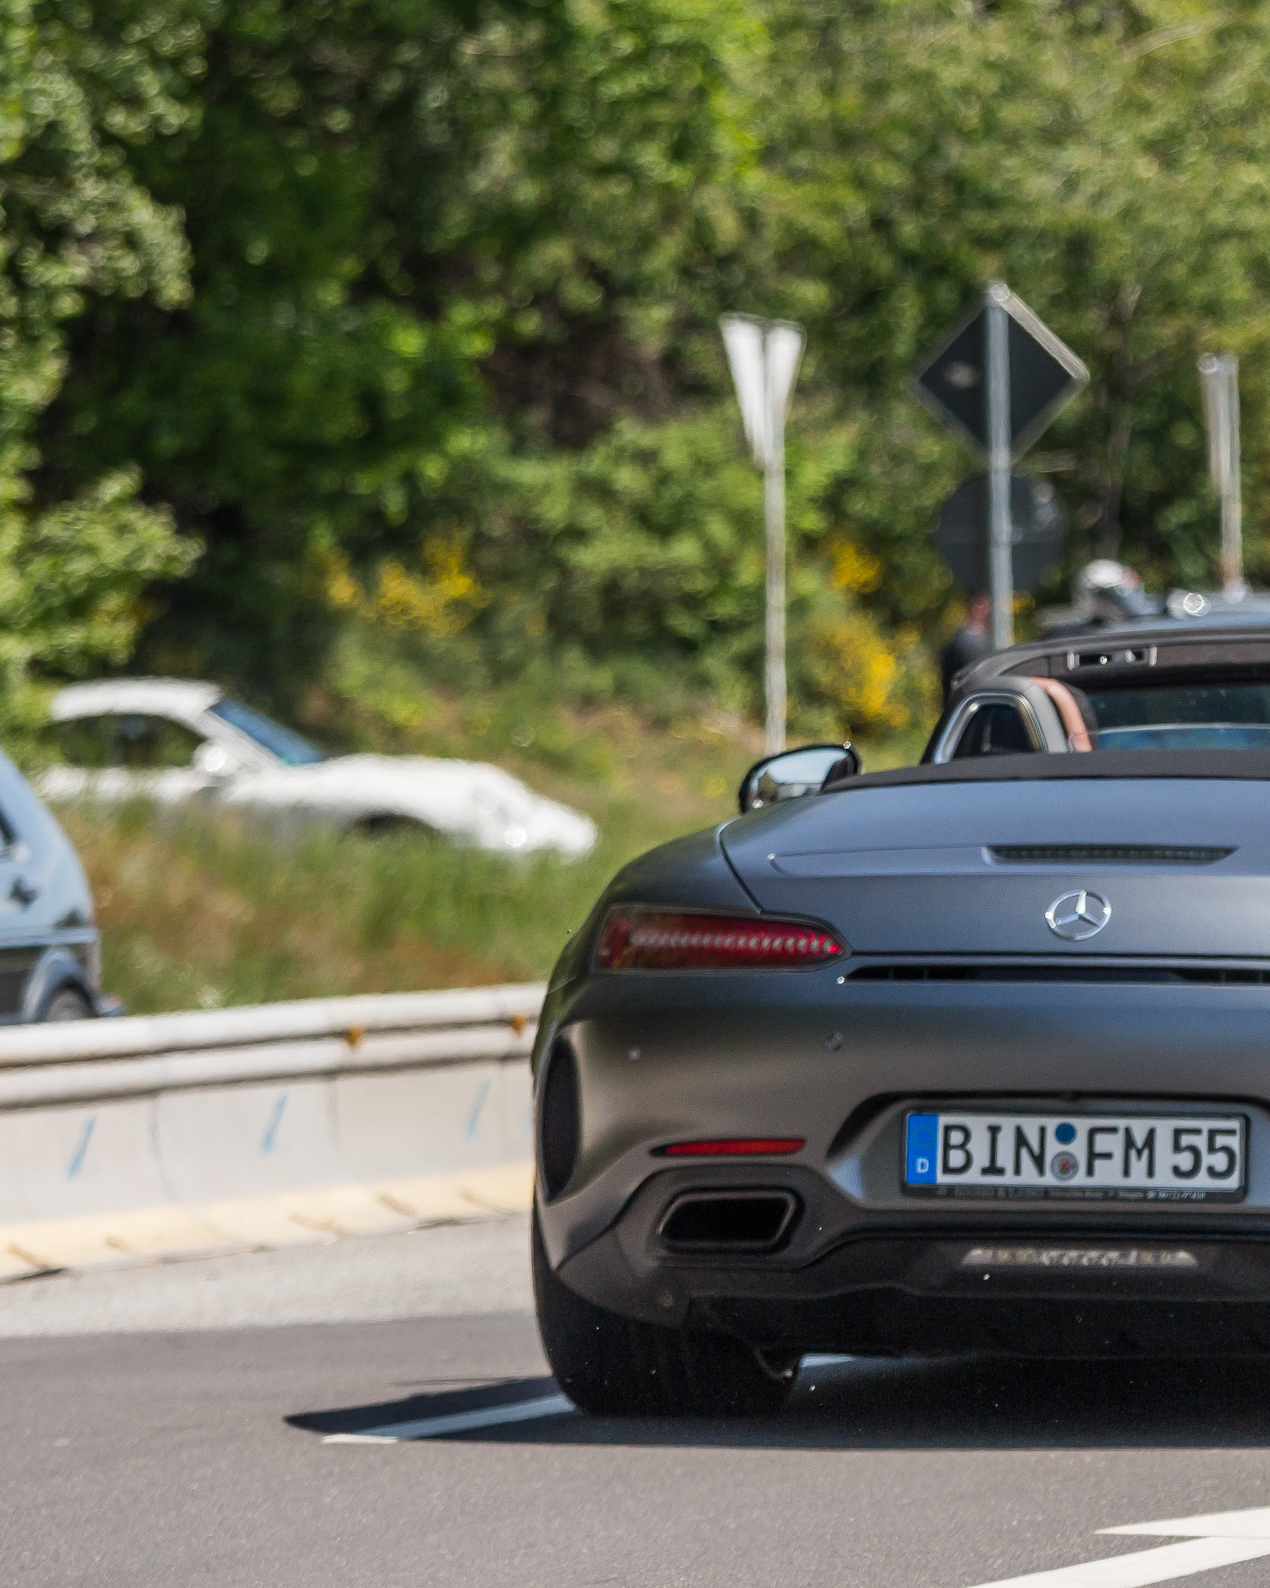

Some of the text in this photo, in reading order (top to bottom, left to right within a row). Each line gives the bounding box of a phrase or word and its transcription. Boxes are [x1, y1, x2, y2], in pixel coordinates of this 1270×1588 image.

[916, 1157, 930, 1174] D
[942, 1124, 1238, 1180] BIN FM 55
